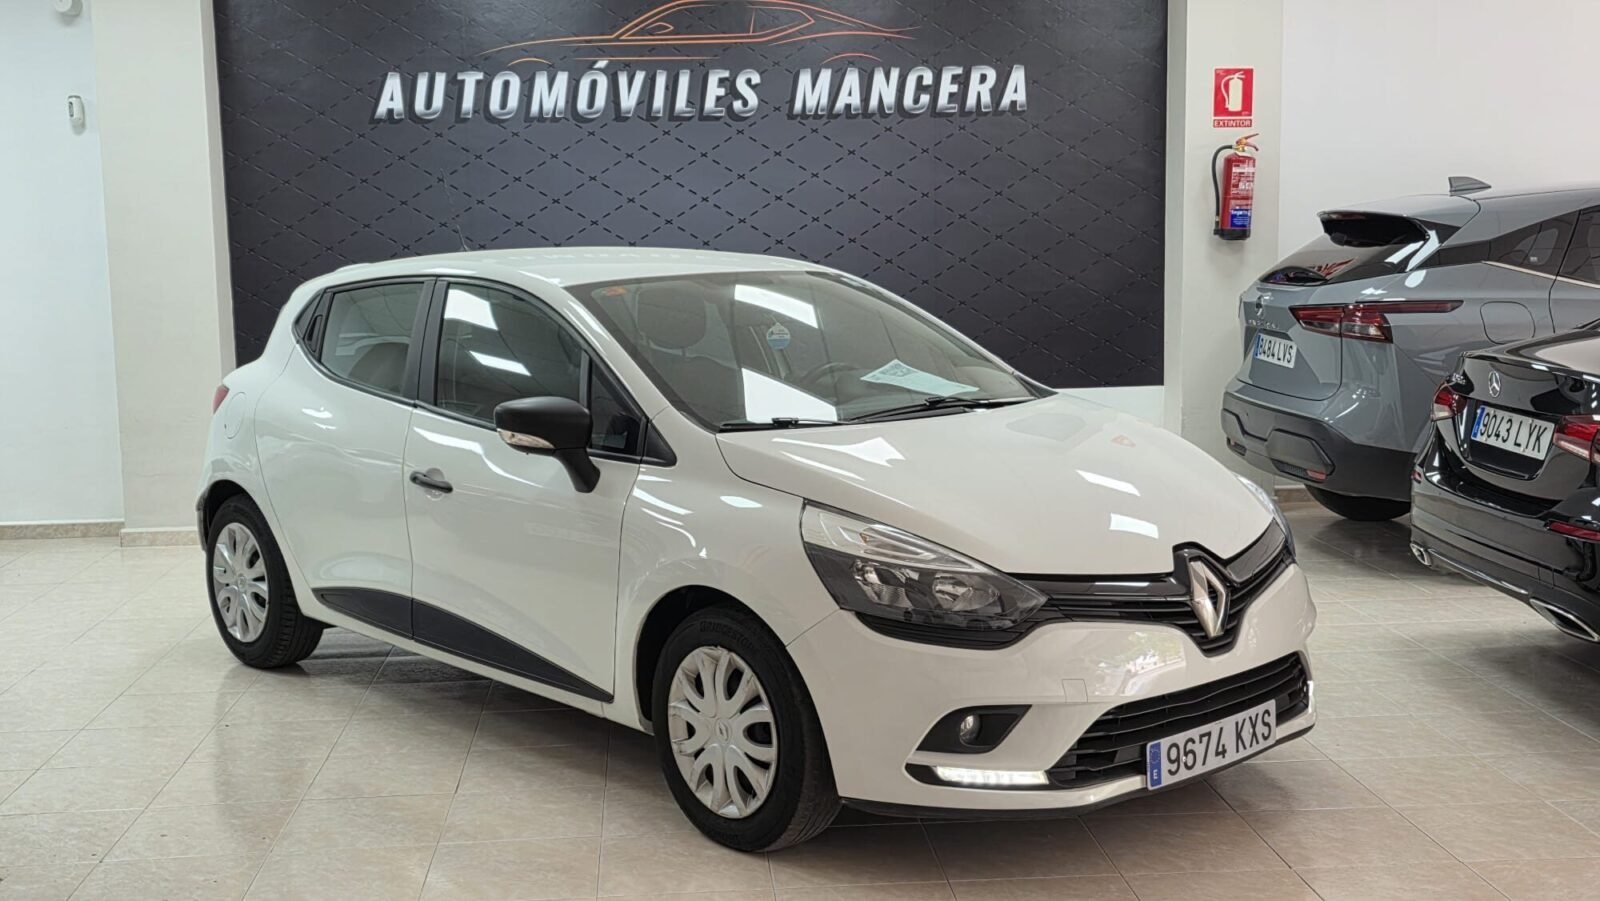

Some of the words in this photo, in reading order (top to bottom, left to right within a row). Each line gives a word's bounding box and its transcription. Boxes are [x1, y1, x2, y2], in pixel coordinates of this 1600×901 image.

[373, 60, 761, 119] AUTOMÓVILES
[795, 64, 1029, 114] MANCERA
[1214, 119, 1252, 127] EXTINTOR
[1480, 411, 1513, 444] 9043
[1514, 420, 1548, 453] LYK
[1166, 726, 1228, 776] 9674
[1235, 708, 1272, 754] KXS
